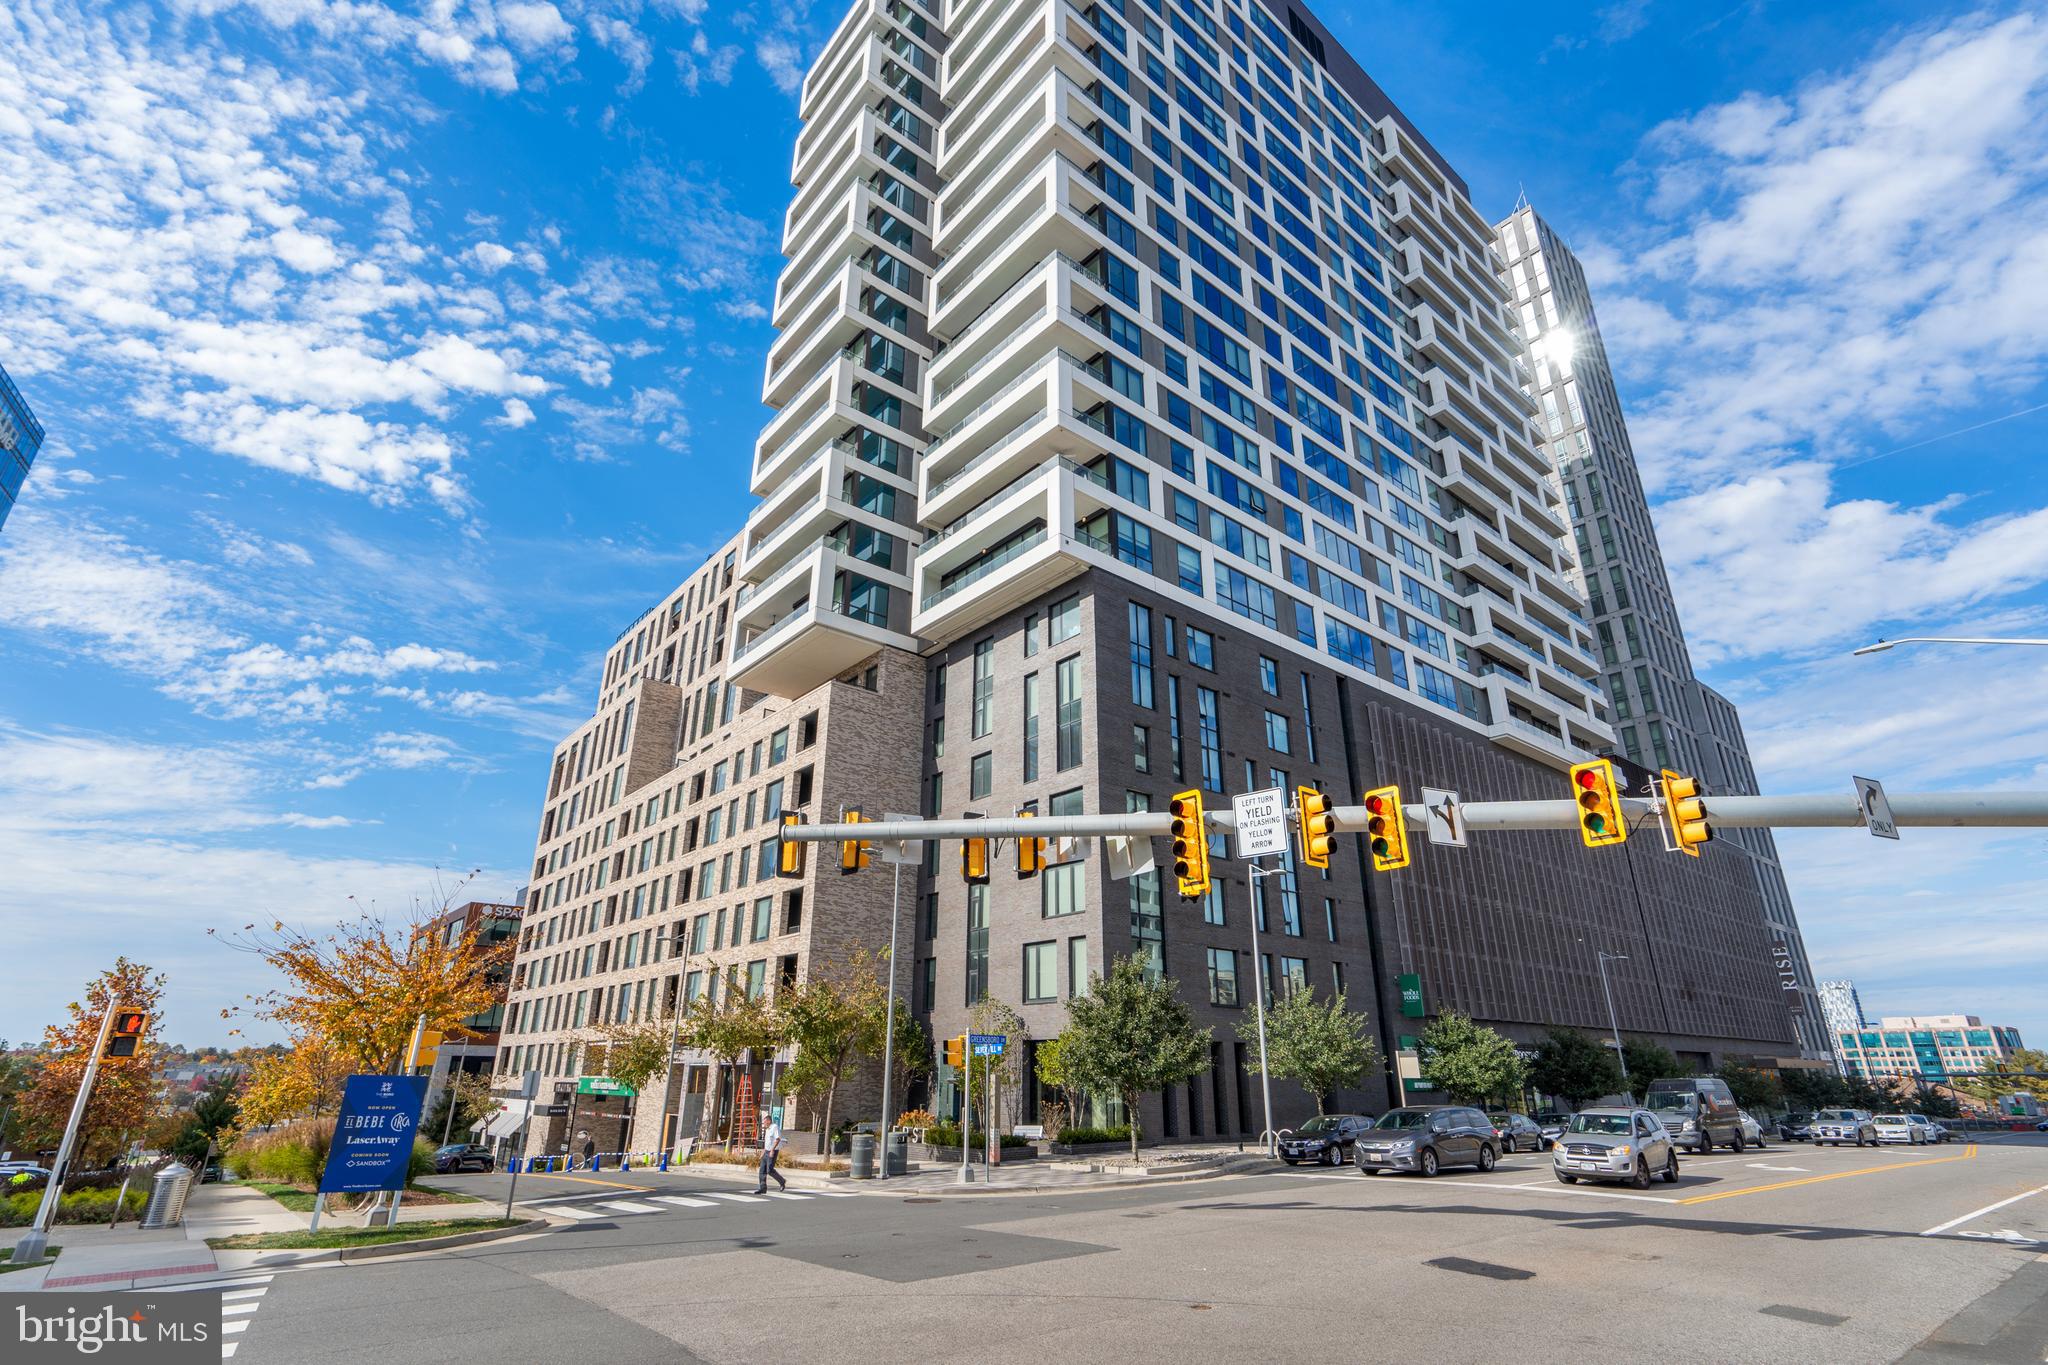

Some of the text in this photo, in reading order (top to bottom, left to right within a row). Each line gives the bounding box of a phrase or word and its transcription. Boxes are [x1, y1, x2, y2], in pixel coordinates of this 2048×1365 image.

[1242, 795, 1274, 807] LEFT TURN
[1246, 806, 1272, 819] YIELD
[1250, 816, 1280, 827] FLASHING
[1249, 828, 1273, 838] YELLOW
[1251, 840, 1273, 849] ARROW
[1772, 947, 1799, 991] RISE
[355, 1115, 386, 1128] BEBE
[390, 1112, 410, 1132] CIRCA
[346, 1135, 401, 1146] LaserAway
